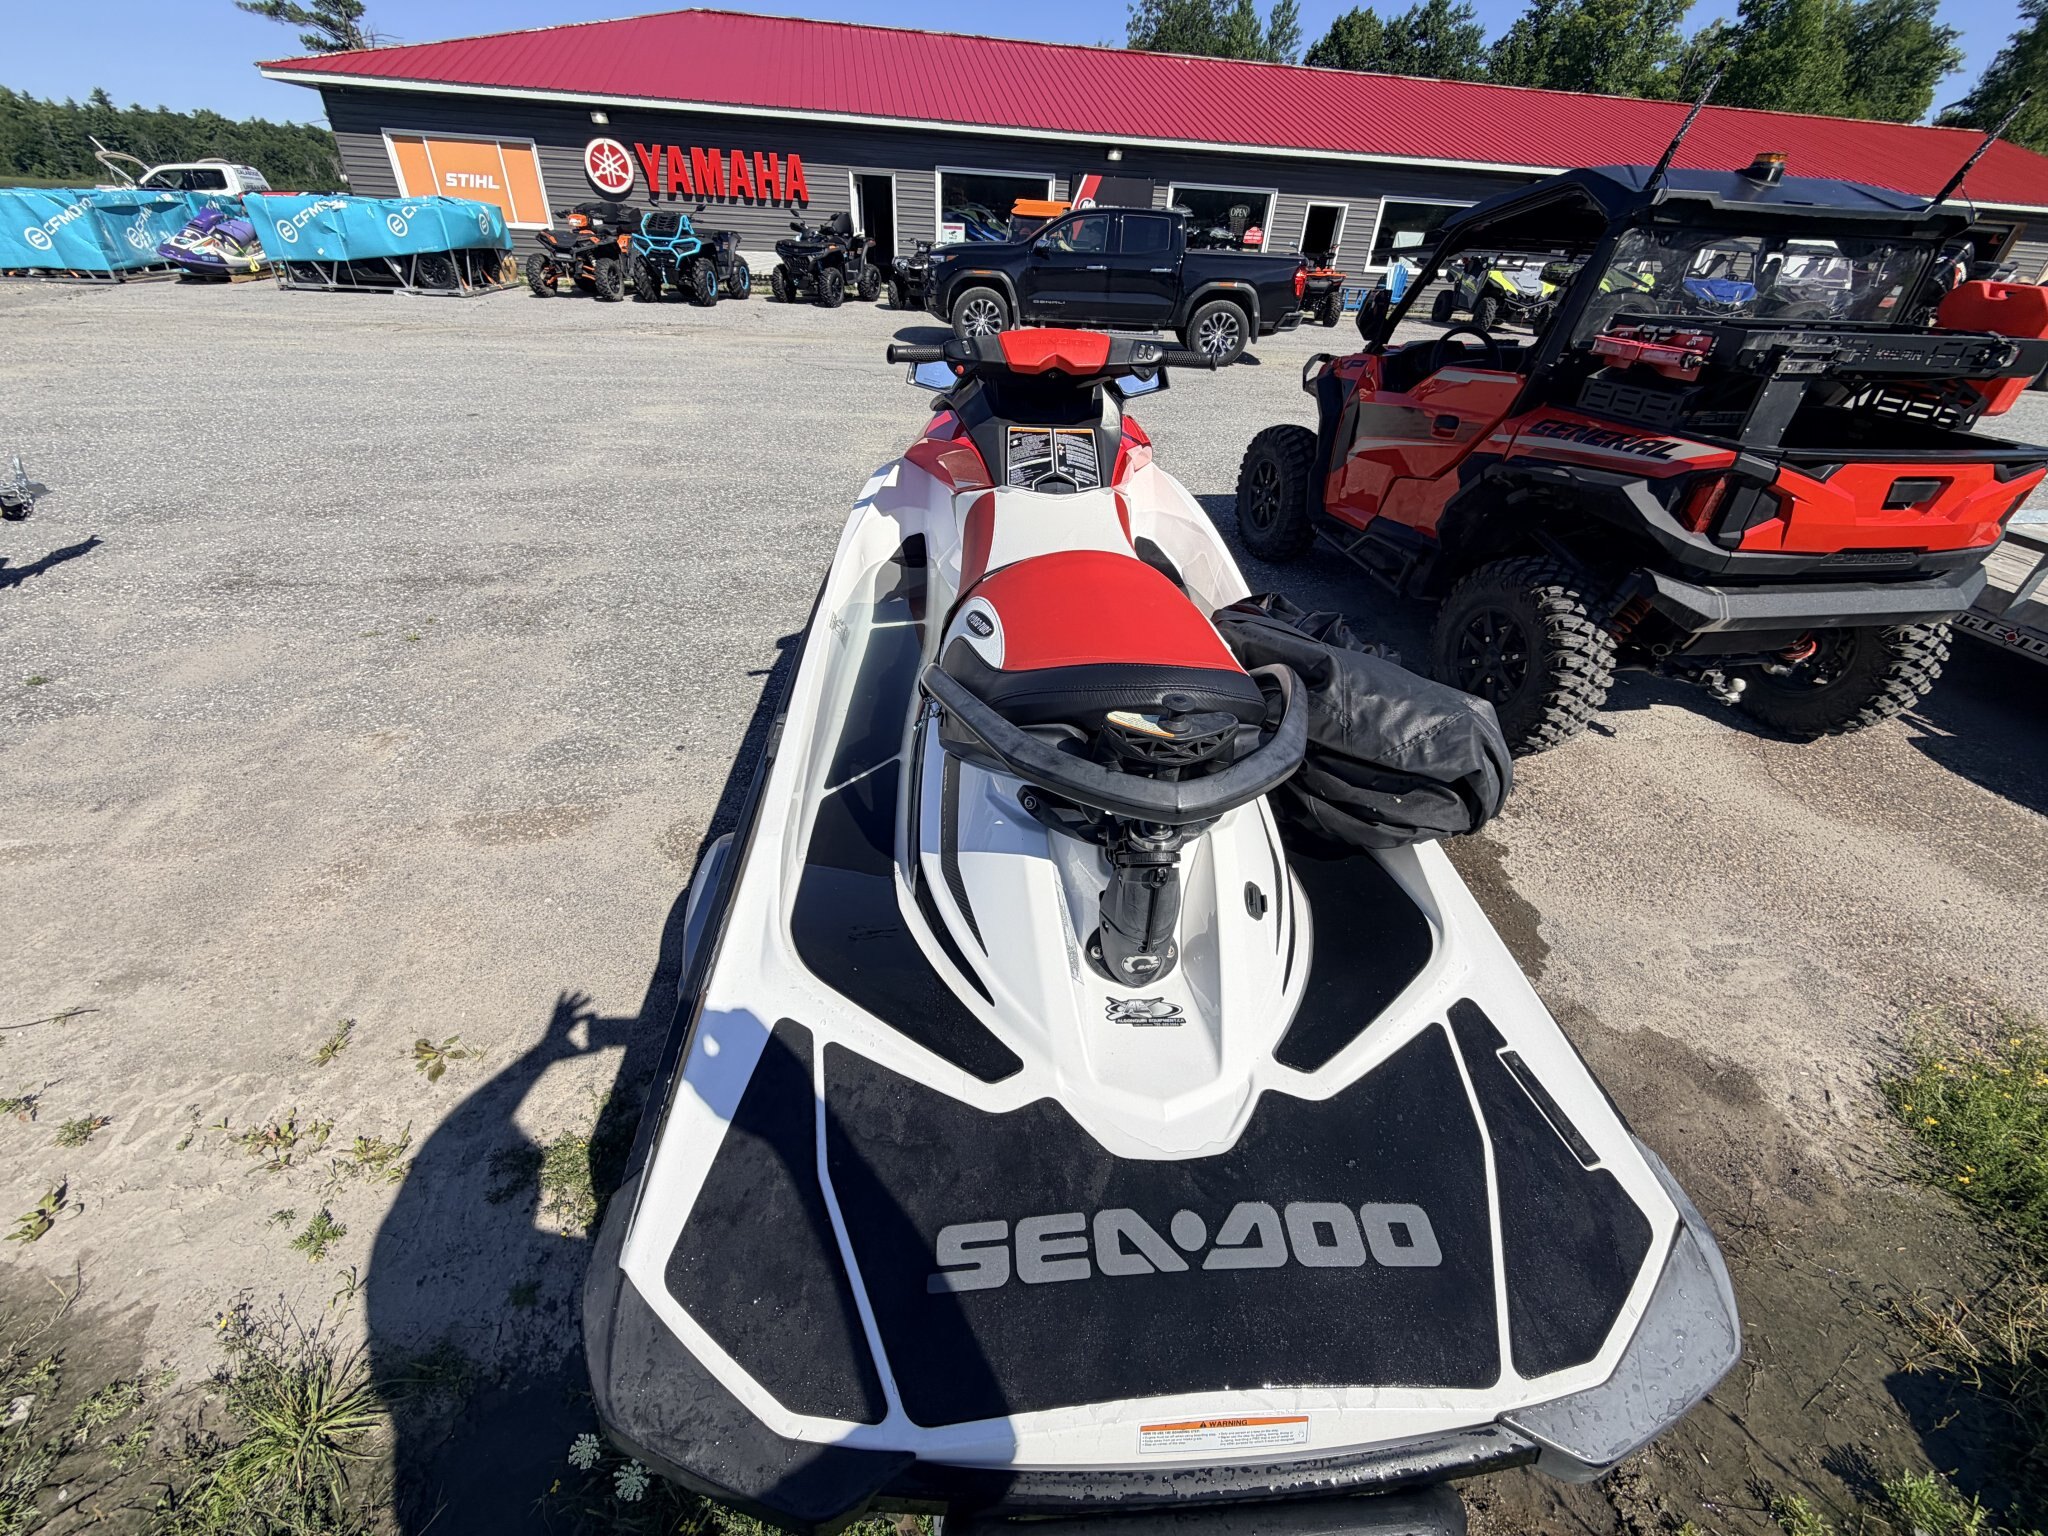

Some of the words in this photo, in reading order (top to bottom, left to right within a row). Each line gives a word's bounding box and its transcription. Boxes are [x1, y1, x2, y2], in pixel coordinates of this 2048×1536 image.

[446, 172, 500, 189] STIHL
[634, 143, 809, 201] YAMAHA
[1230, 207, 1248, 218] OPEN
[1527, 418, 1683, 460] GENERAL
[1954, 612, 2012, 640] TRUE
[1209, 1419, 1248, 1428] WARNING
